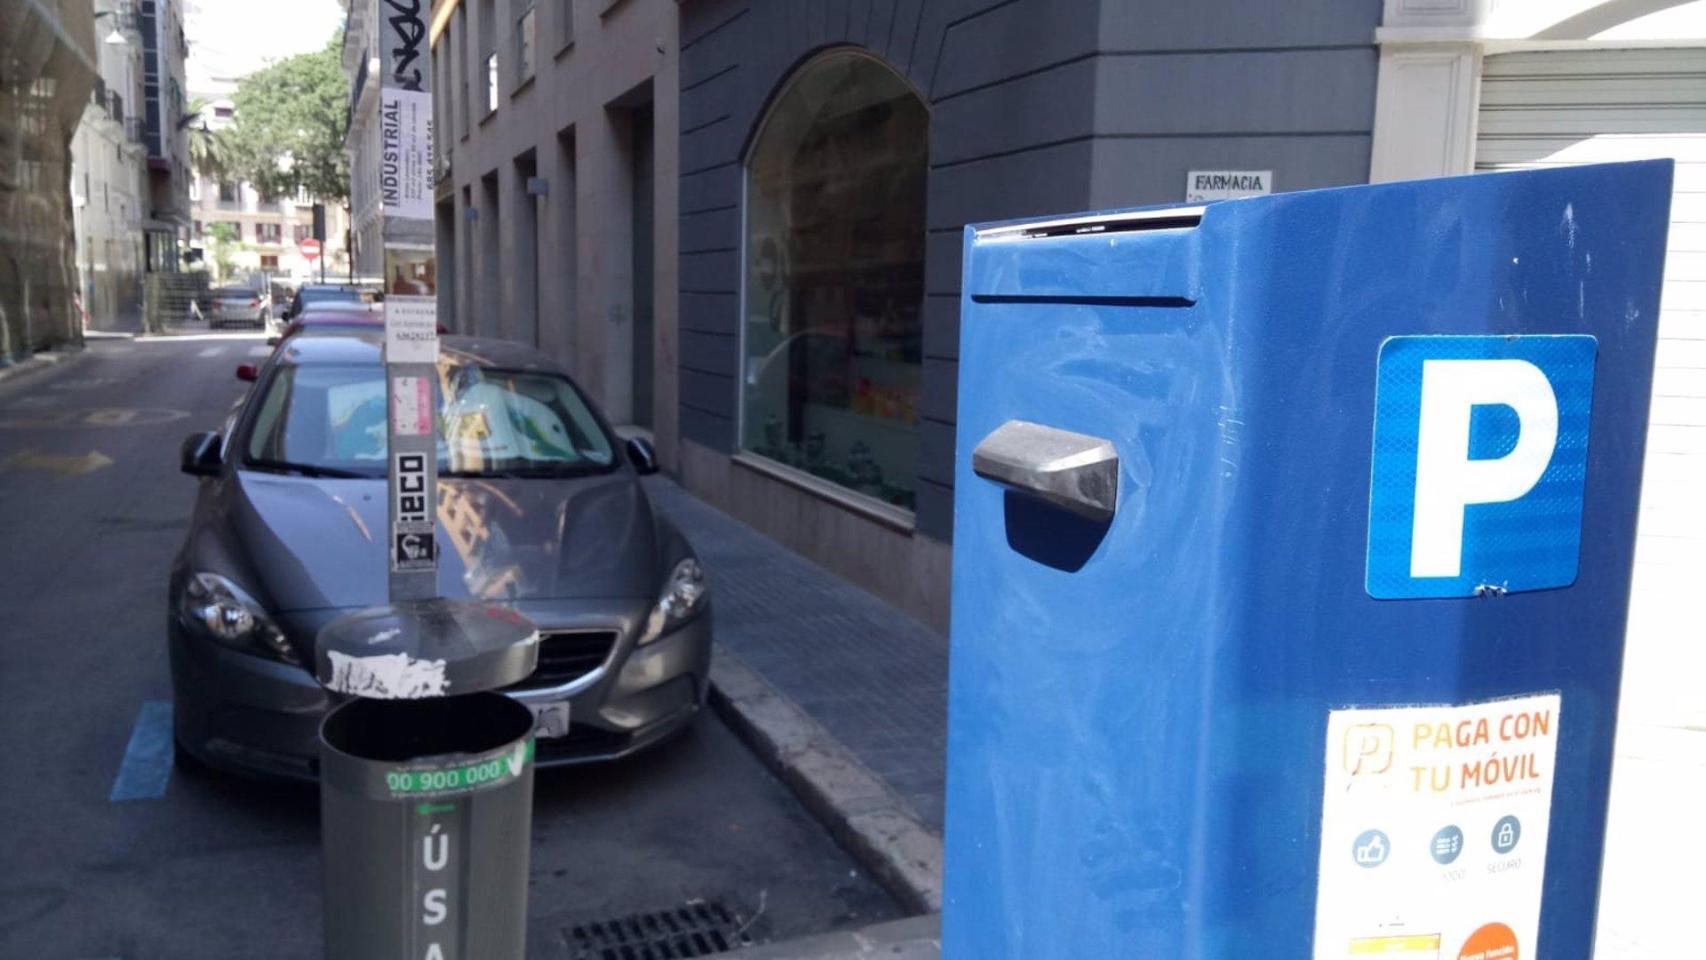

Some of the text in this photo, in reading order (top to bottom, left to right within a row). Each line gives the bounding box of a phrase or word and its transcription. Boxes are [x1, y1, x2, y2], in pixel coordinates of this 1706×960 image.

[383, 100, 399, 208] INDUSTRIAL
[1410, 359, 1559, 578] P
[1412, 710, 1550, 749] PAGA CON
[419, 771, 460, 789] 900
[466, 761, 500, 784] 000
[1409, 751, 1540, 792] TU MÓVIL
